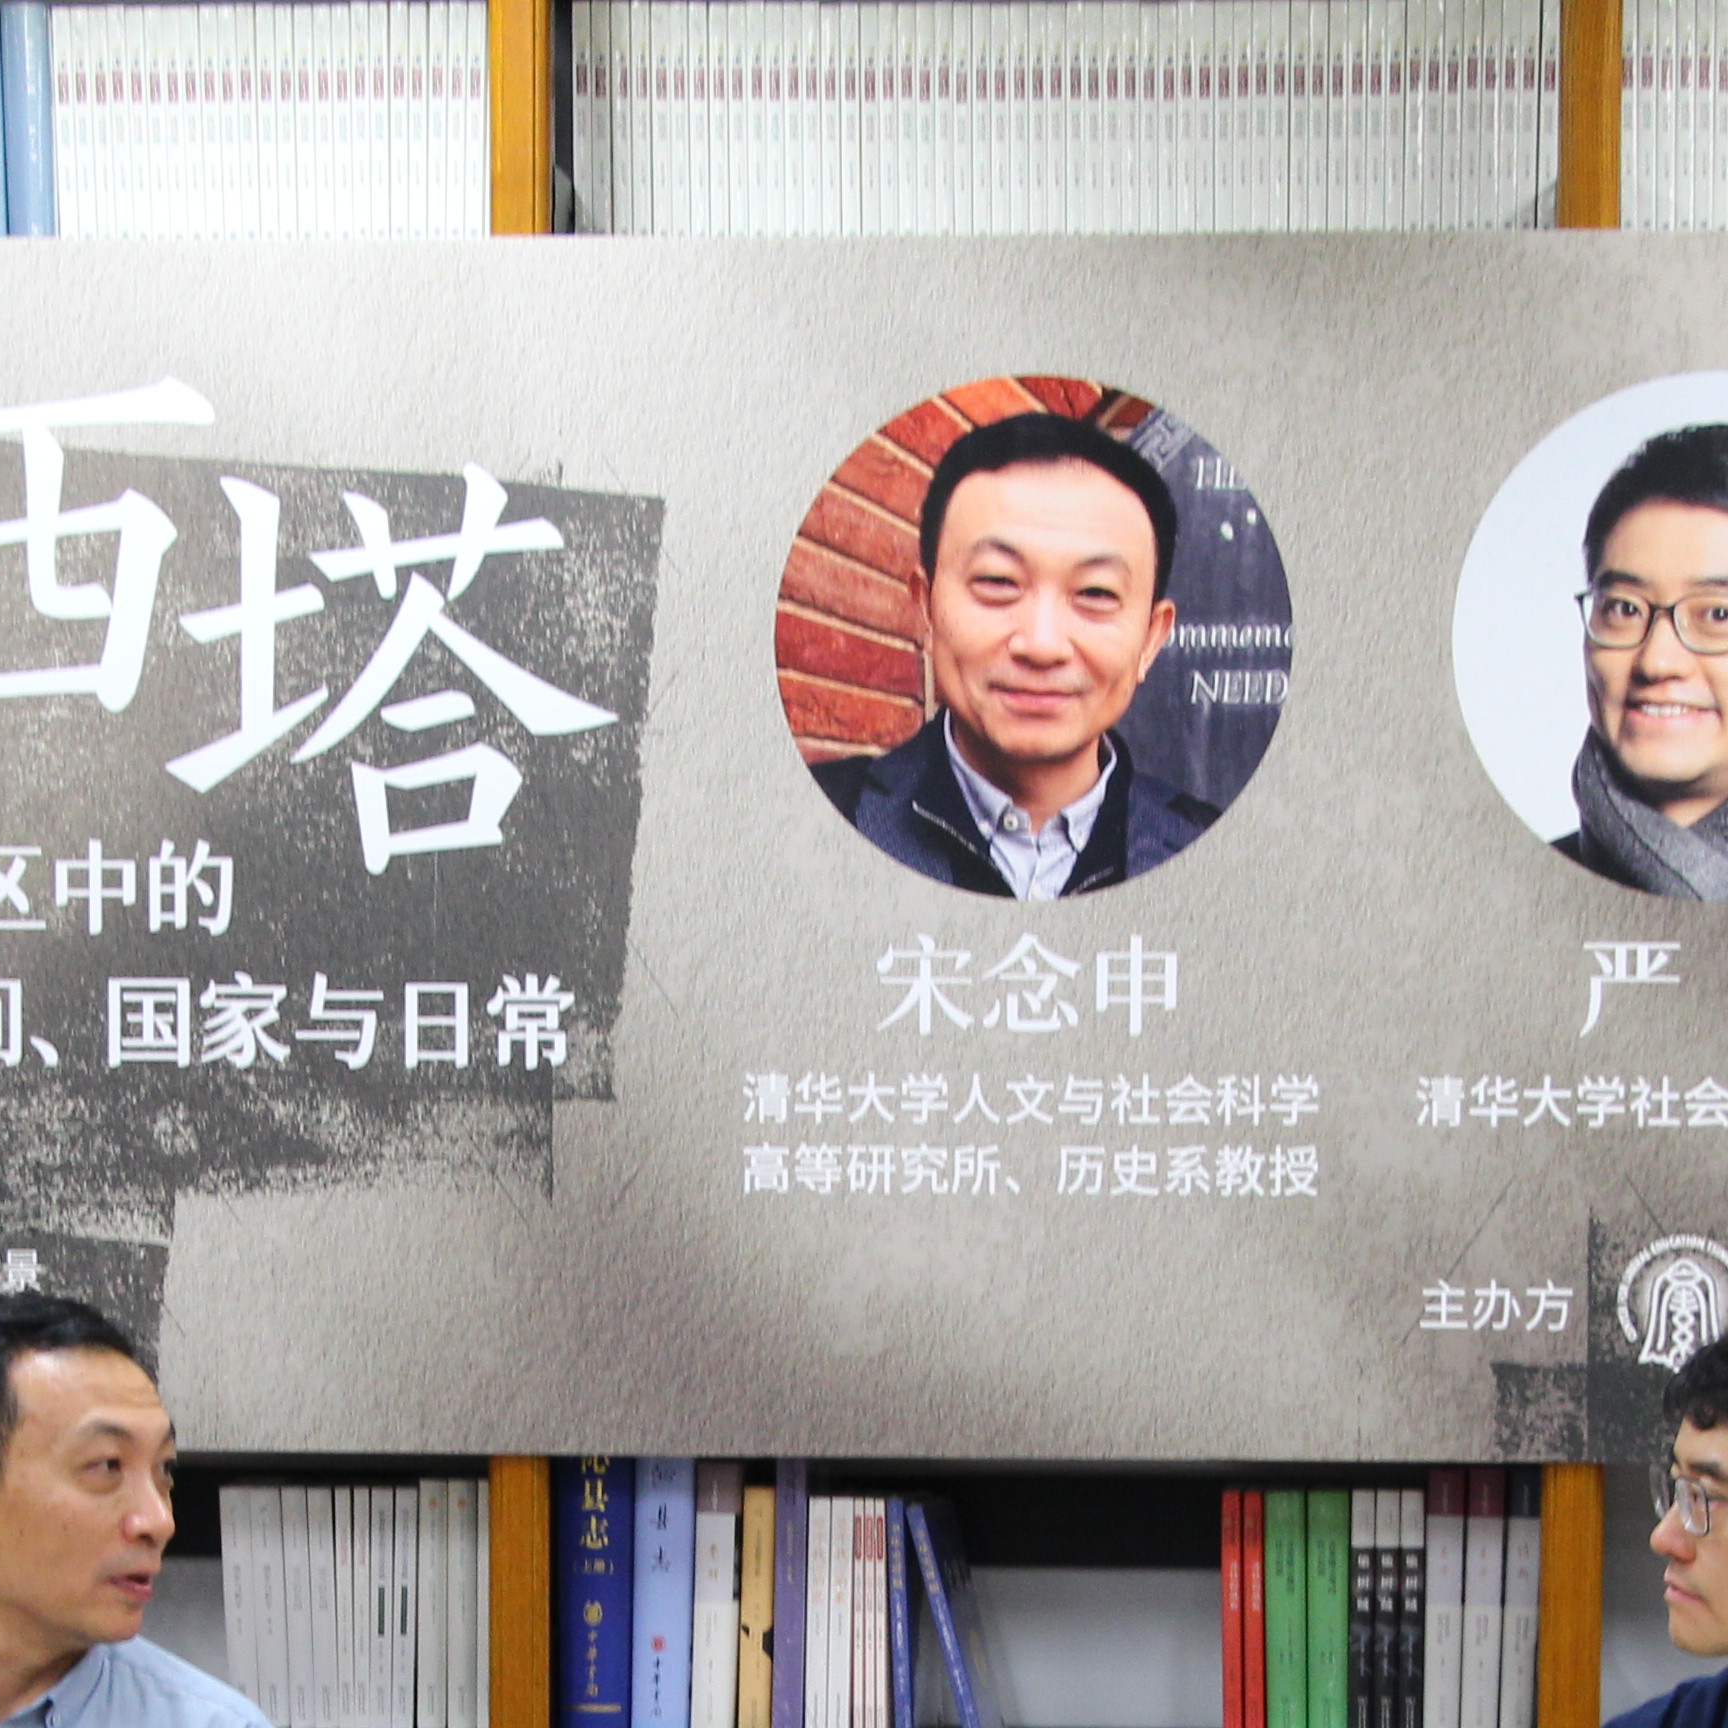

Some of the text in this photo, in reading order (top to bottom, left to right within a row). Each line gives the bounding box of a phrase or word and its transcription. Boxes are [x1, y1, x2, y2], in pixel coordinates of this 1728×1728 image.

[874, 931, 1180, 1038] 宋念申
[741, 1070, 1321, 1127] 清华大学人文与社会科学
[741, 1141, 1321, 1198] 高等研究所、历史系教授
[1418, 1278, 1575, 1333] 主办方
